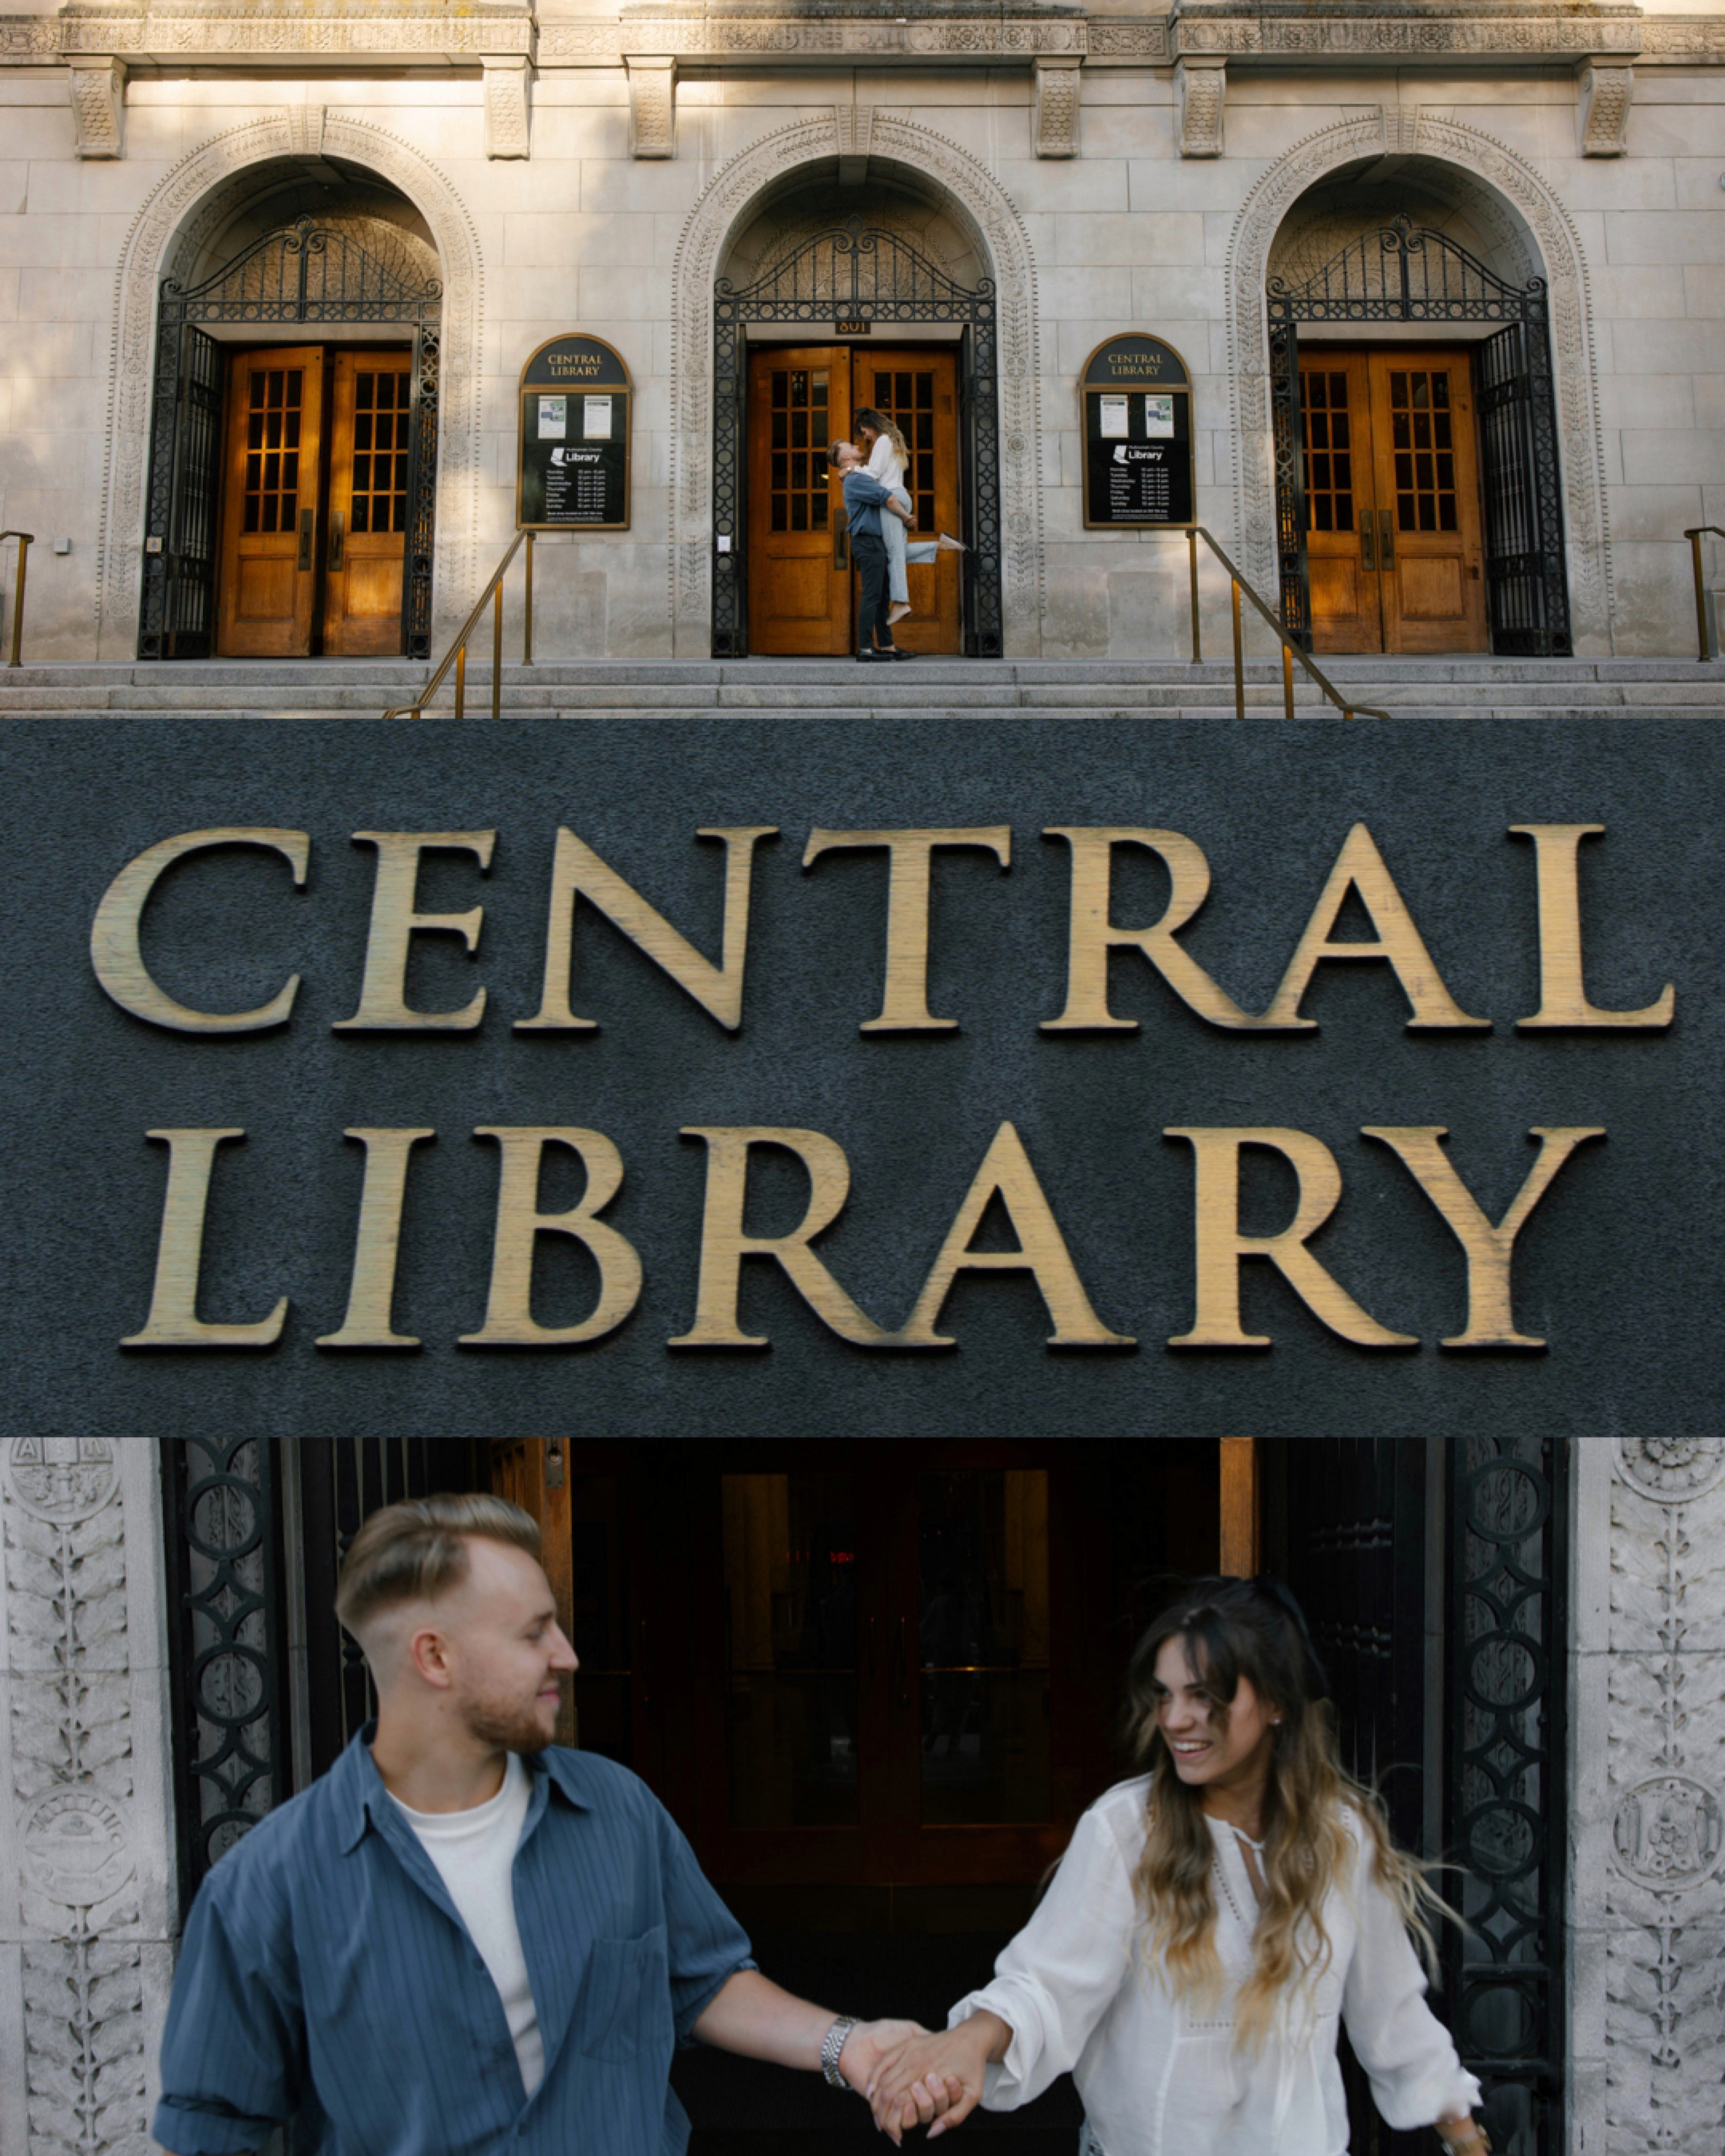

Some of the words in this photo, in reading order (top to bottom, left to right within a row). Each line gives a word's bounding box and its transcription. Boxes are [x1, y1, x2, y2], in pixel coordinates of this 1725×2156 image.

[840, 322, 865, 332] 801
[547, 354, 602, 364] CENTRAL
[1108, 354, 1163, 363] CENTRAL
[551, 366, 600, 376] LIBRARY
[1111, 365, 1160, 375] LIBRARY
[565, 453, 600, 464] Library
[1128, 450, 1163, 461] Library
[89, 823, 1676, 1032] CENTRAL
[120, 1121, 1608, 1348] LIBRARY
